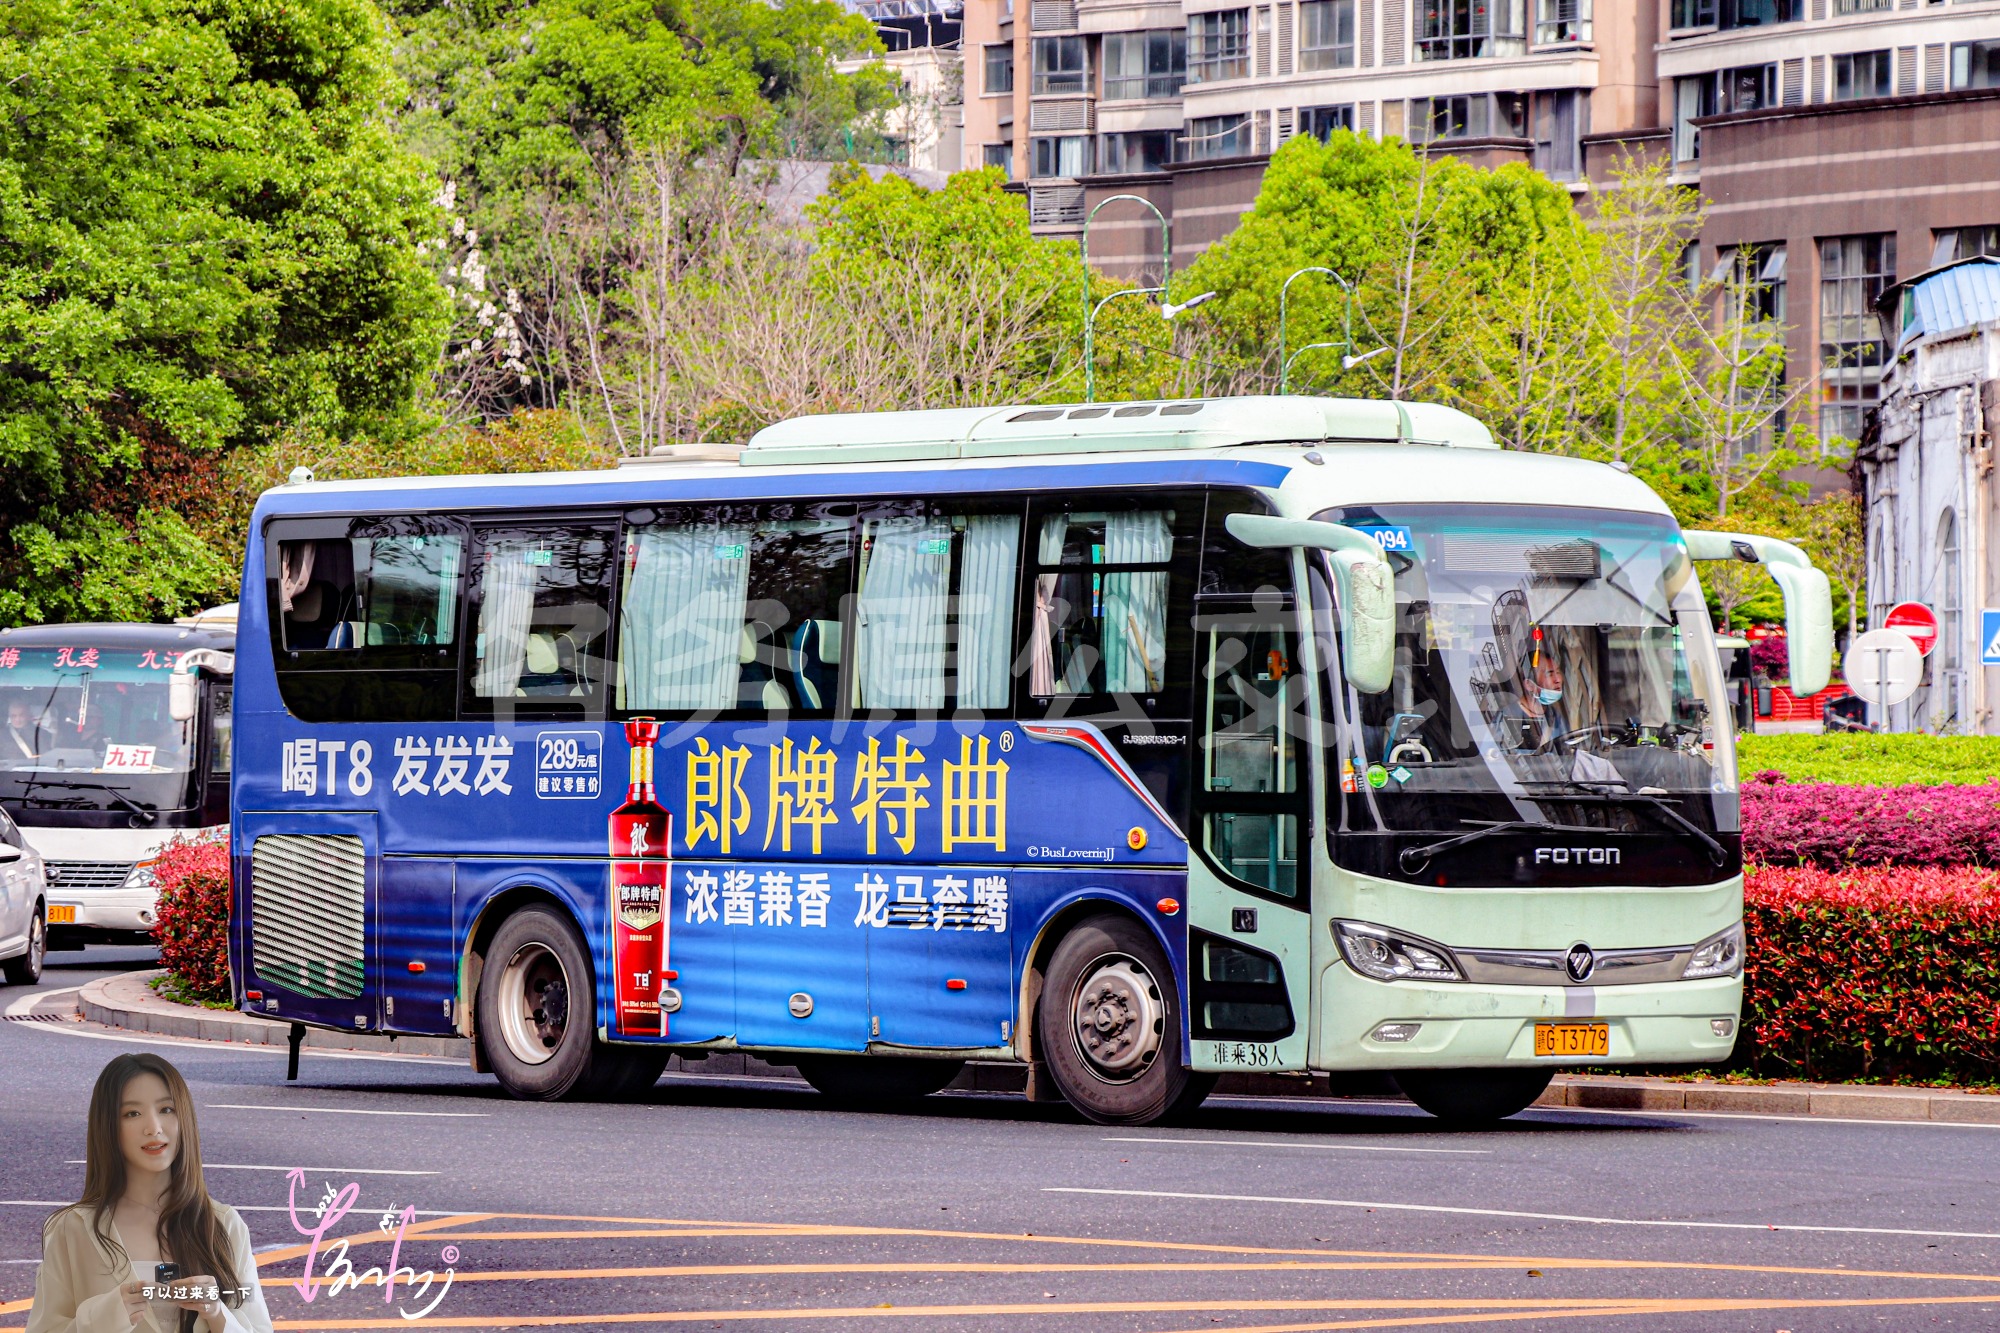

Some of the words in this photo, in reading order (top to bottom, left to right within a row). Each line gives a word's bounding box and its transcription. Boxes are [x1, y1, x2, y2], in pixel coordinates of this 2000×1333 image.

[106, 747, 152, 767] 九江
[281, 738, 373, 797] 喝T8
[392, 734, 515, 797] 发发发
[538, 776, 599, 793] 建议零售价
[684, 734, 1010, 855] 郎牌特曲
[1535, 847, 1620, 865] FOTON
[621, 885, 660, 901] 郎牌特曲
[684, 869, 832, 928] 浓酱兼香
[853, 872, 1009, 933] 龙马奔腾
[1214, 1042, 1284, 1067] 准乘38人
